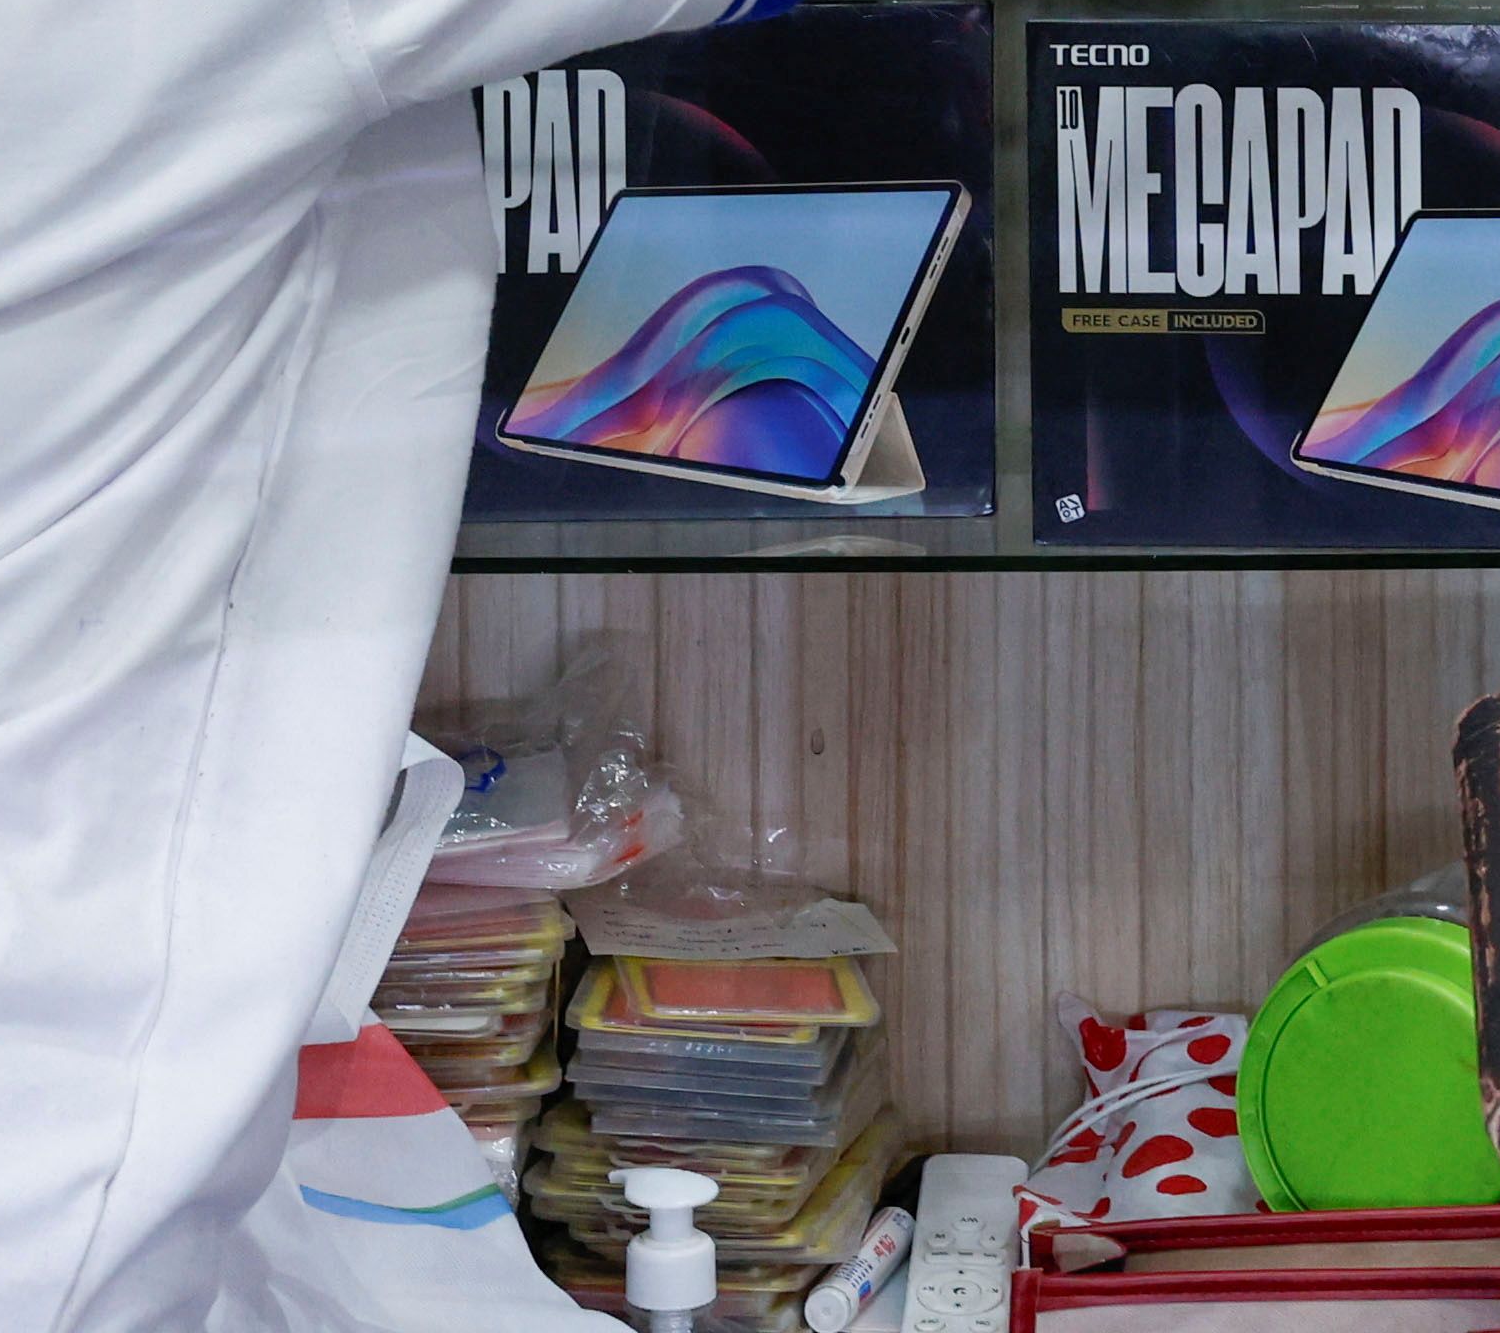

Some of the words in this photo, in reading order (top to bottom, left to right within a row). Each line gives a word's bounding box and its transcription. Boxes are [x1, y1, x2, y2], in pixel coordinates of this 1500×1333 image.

[1050, 45, 1150, 67] TECNO
[1060, 89, 1078, 130] 10
[1056, 83, 1422, 297] MEGAPAD
[1072, 315, 1109, 327] FREE
[1118, 315, 1160, 327] CASE
[1172, 313, 1259, 331] INCLUDED
